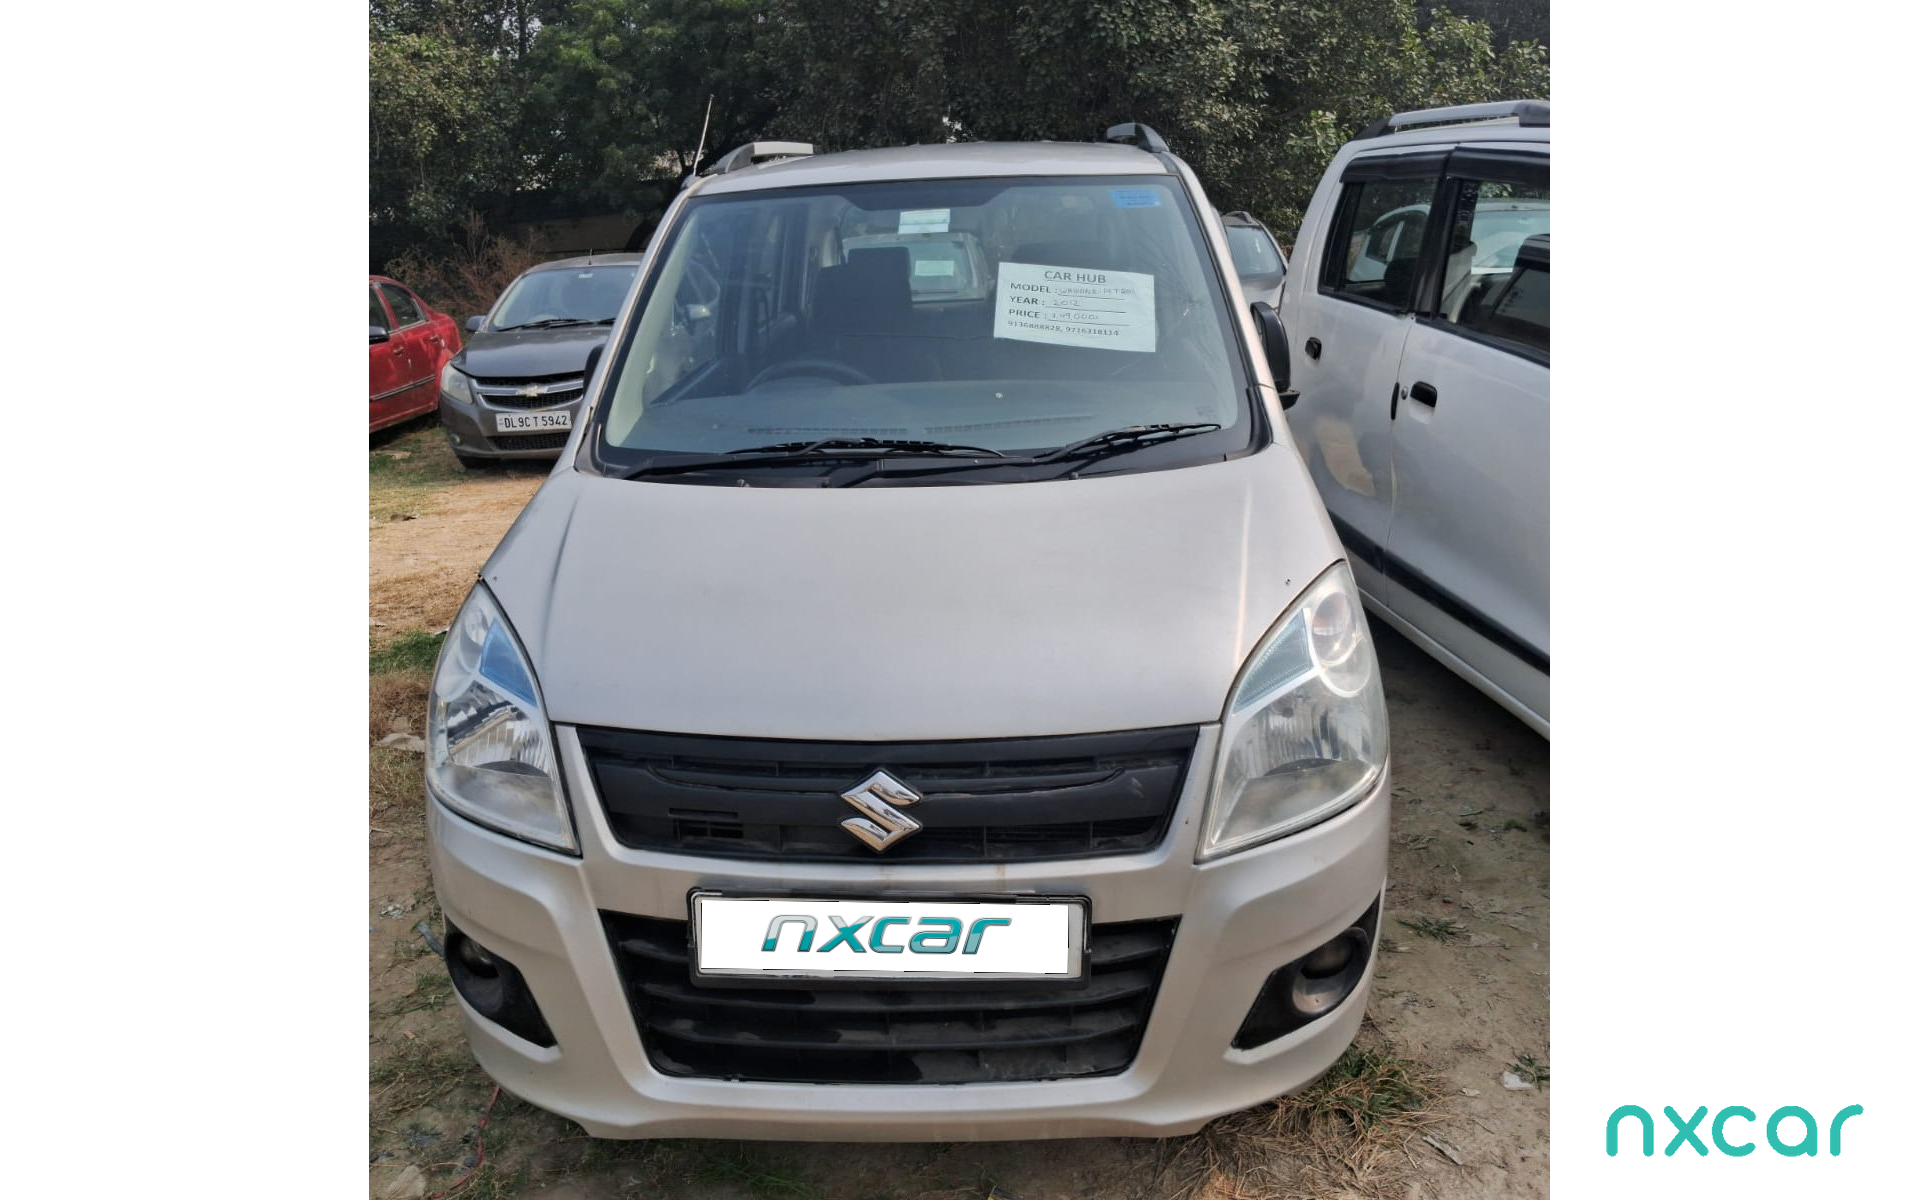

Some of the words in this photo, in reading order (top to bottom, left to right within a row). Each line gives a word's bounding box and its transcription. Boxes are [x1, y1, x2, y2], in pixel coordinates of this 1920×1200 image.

[1044, 271, 1072, 281] CAR
[1076, 273, 1106, 284] HUB
[1010, 282, 1052, 294] MODEL
[1010, 295, 1039, 305] YEAR
[1009, 308, 1041, 319] PRICE
